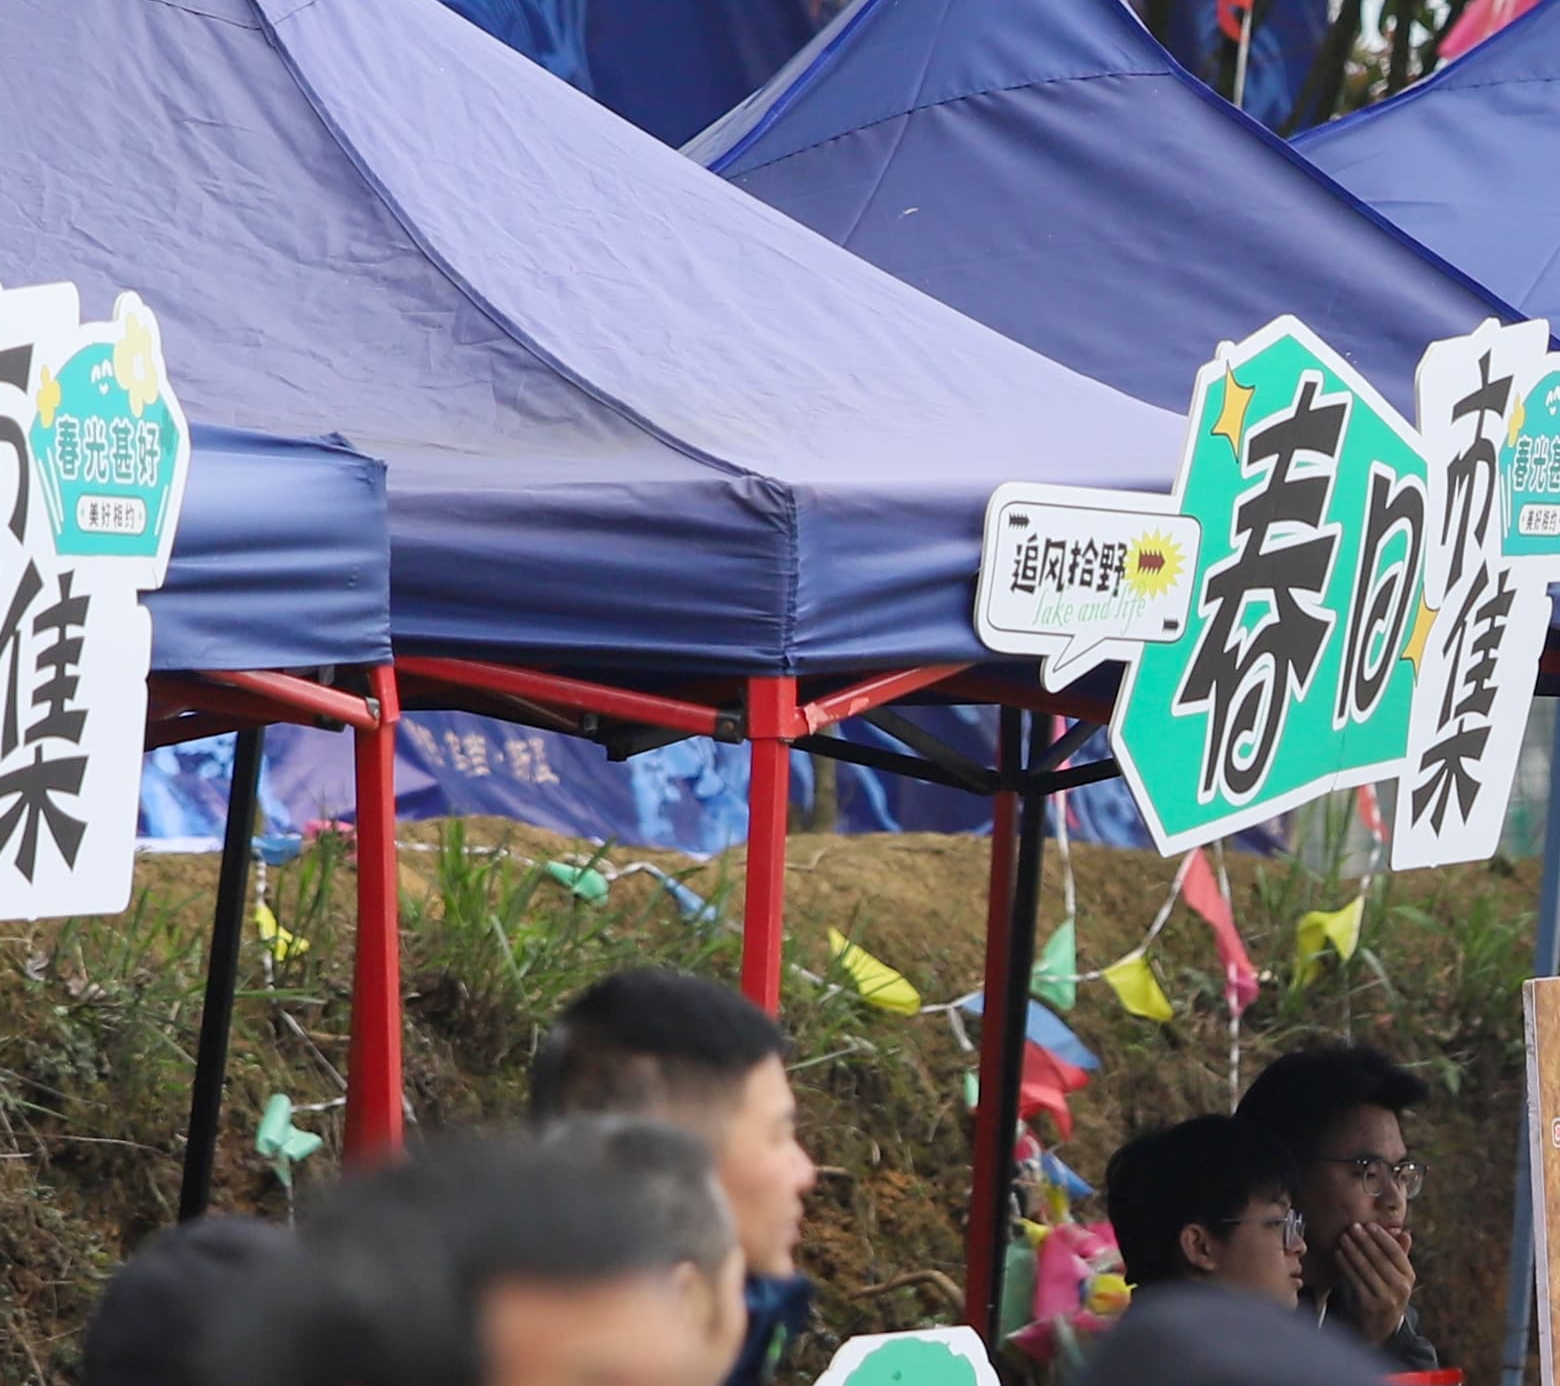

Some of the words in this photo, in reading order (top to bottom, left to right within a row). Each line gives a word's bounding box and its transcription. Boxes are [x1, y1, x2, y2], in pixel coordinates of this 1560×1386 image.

[55, 414, 159, 487] 春光甚好
[90, 502, 134, 529] 美好相约
[1010, 533, 1127, 597] 追风拾野
[1177, 381, 1427, 795] 春日
[1411, 350, 1515, 836] 市集
